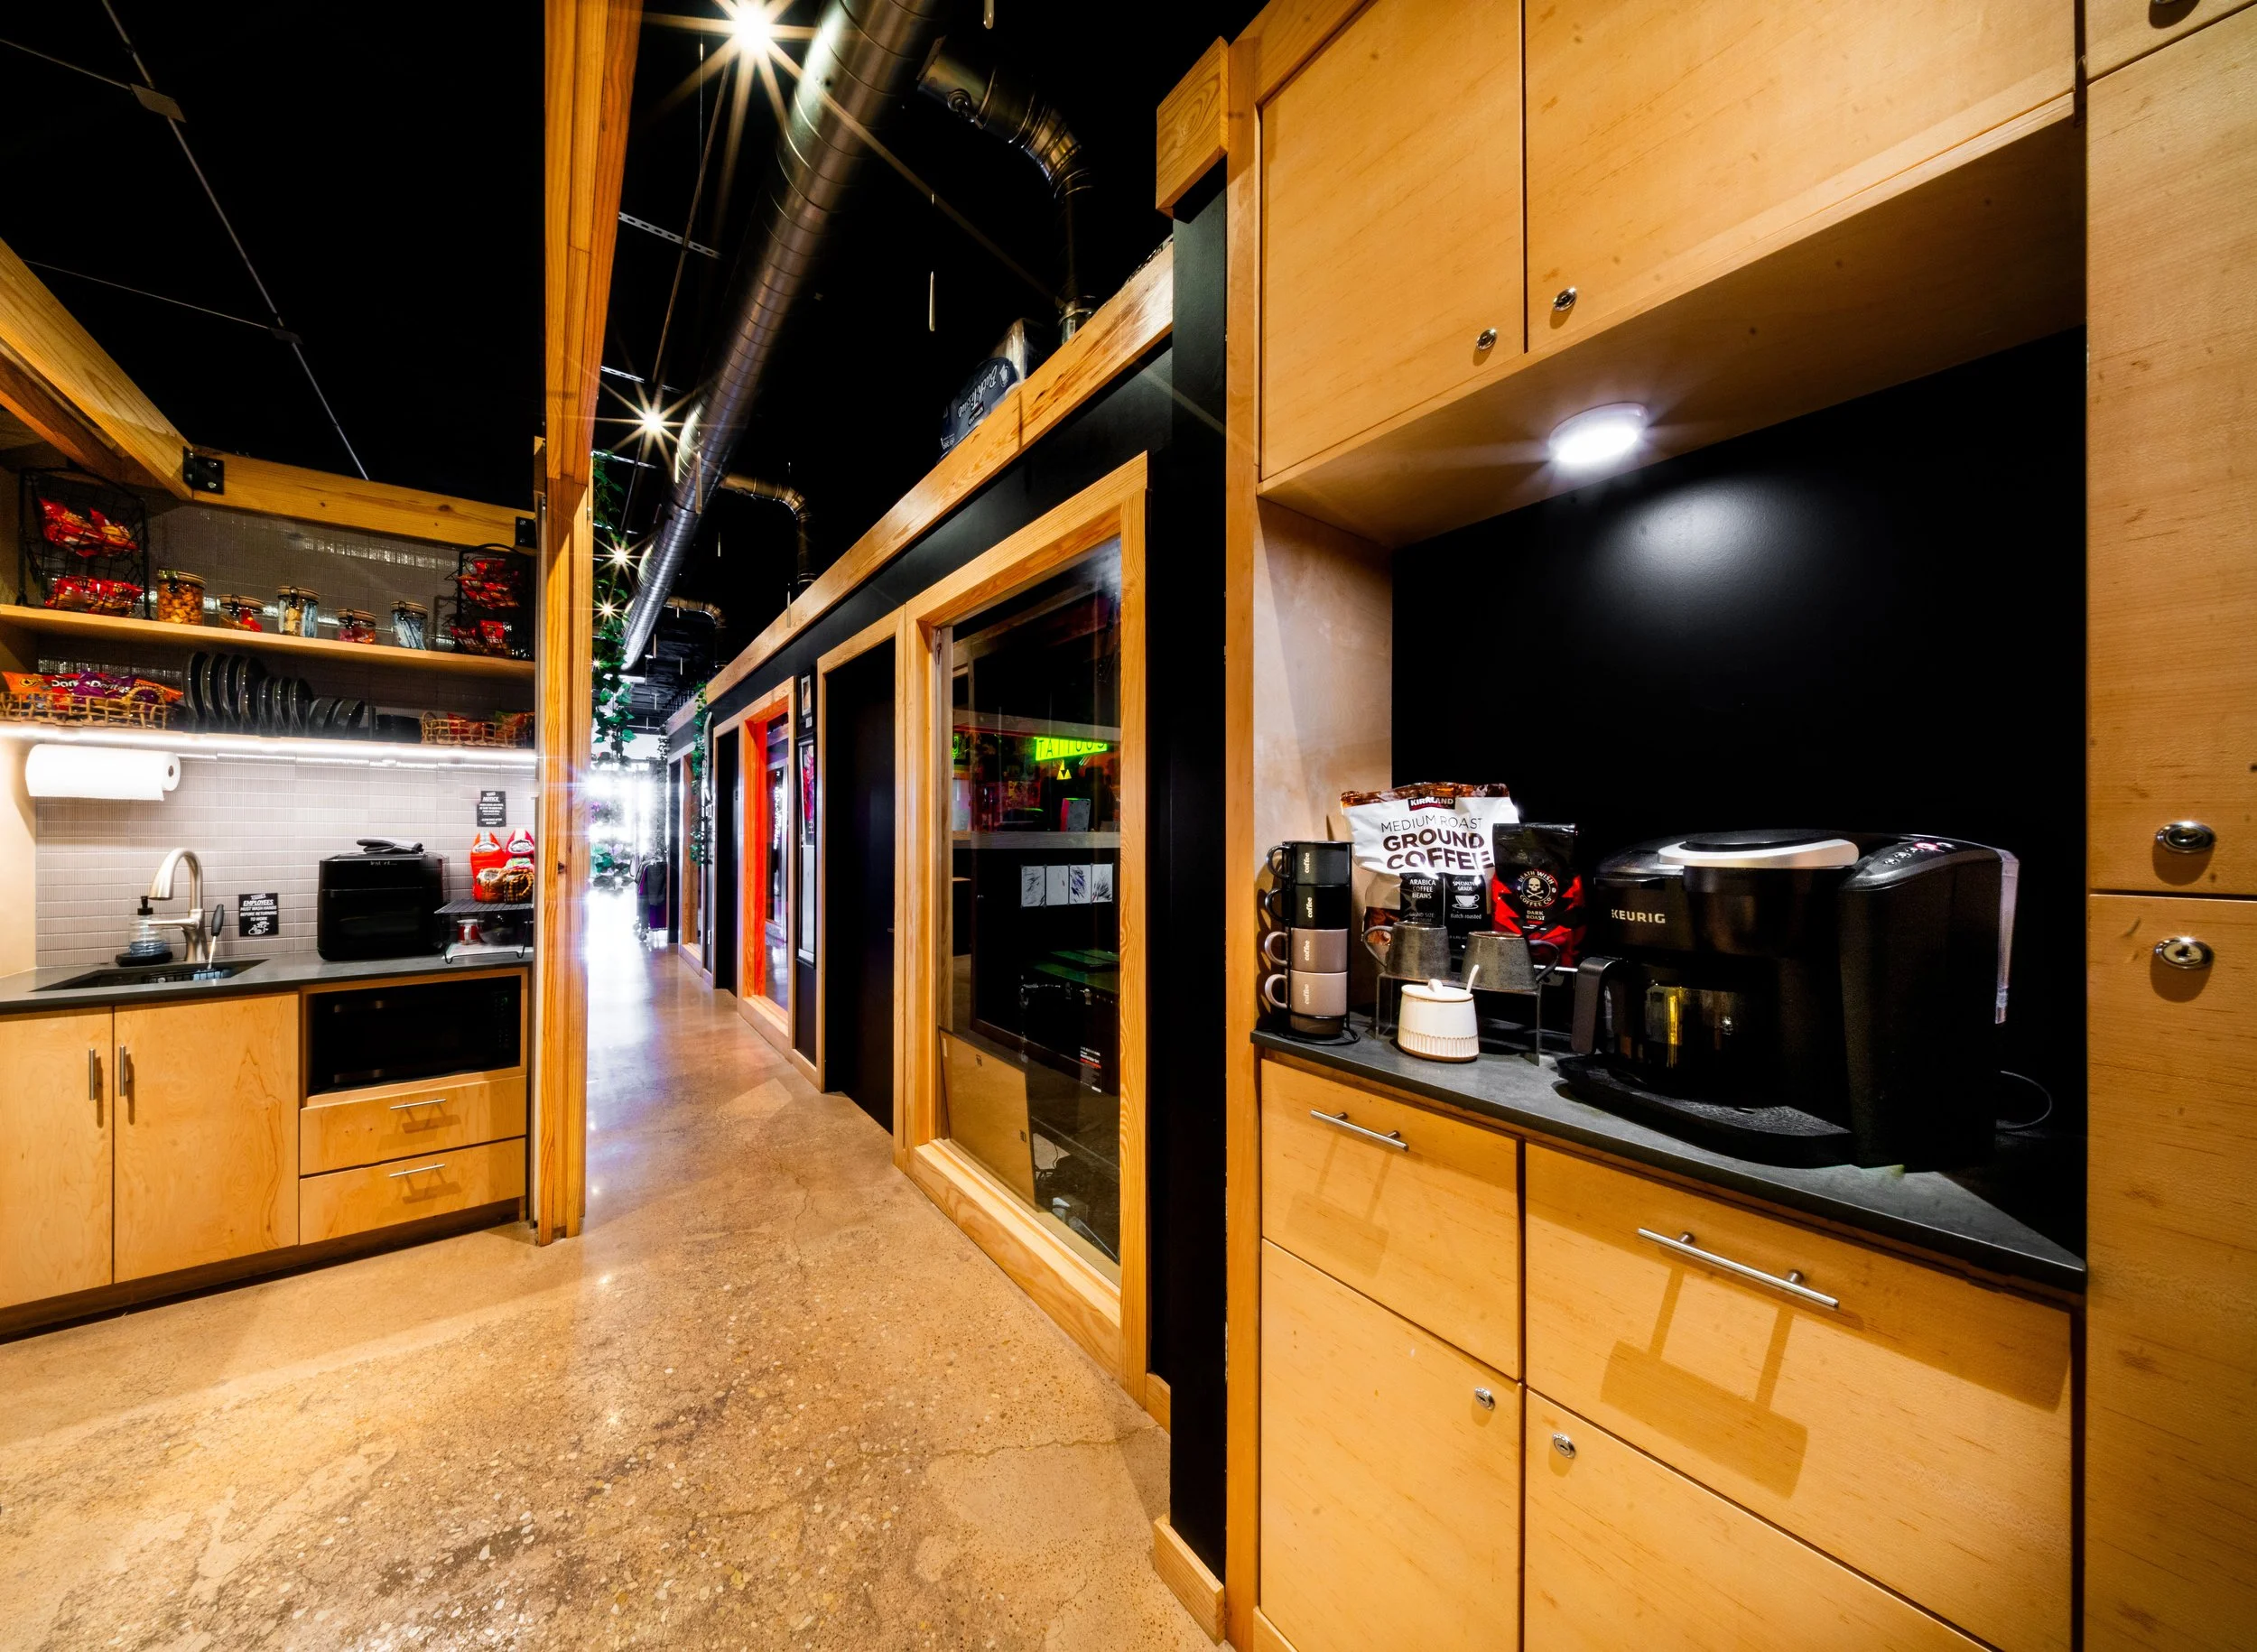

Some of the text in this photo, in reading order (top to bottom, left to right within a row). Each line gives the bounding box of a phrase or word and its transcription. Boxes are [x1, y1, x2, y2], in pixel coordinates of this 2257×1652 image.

[1410, 796, 1454, 807] KIRKLAND
[1381, 814, 1483, 832] MEDIUM ROAST
[1383, 828, 1485, 851] GROUND
[1387, 847, 1494, 869] COFFEE
[1518, 870, 1555, 885] DEATH WISH
[1519, 895, 1542, 907] COFFEE
[1611, 909, 1666, 923] KEURIG
